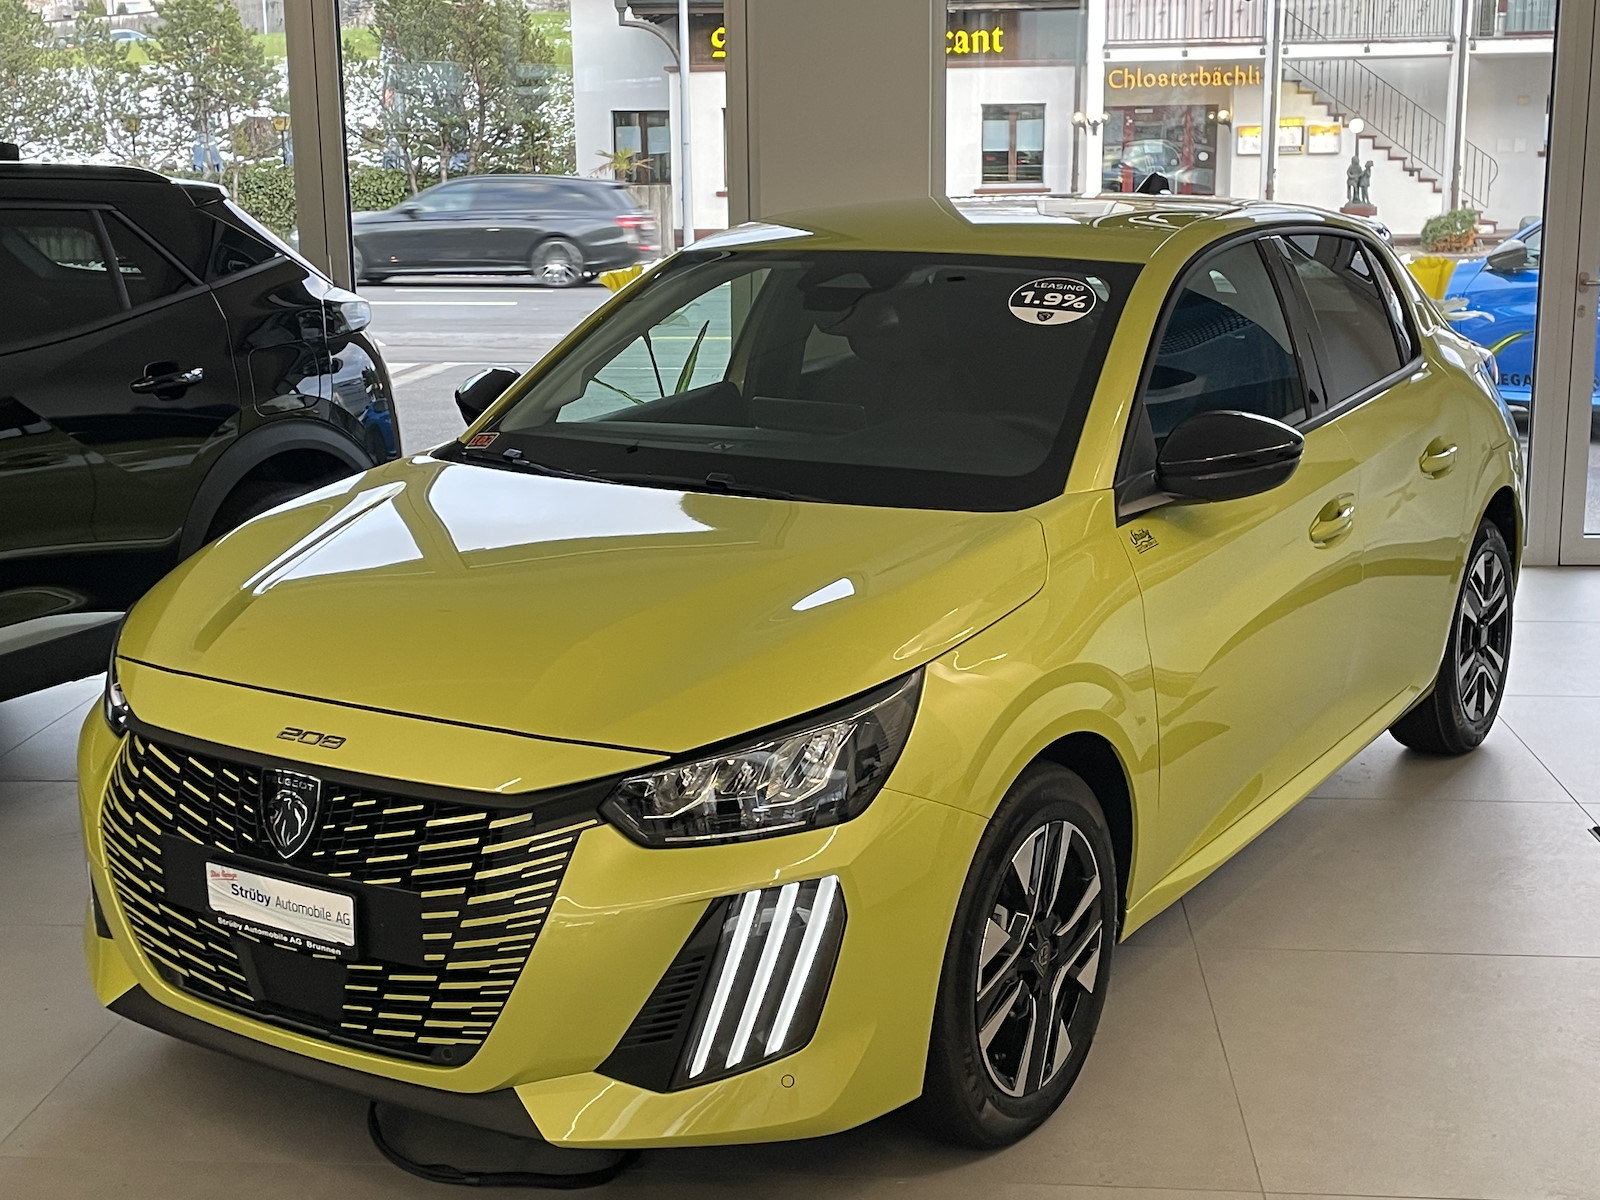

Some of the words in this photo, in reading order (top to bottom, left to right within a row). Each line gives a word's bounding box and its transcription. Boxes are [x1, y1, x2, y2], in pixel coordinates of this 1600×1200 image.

[1108, 65, 1262, 91] Chlosterbächli
[1034, 282, 1084, 291] LEASING
[1020, 290, 1088, 309] 1.9%
[277, 727, 347, 750] 208
[231, 883, 271, 907] Strüby
[275, 896, 332, 922] Automobile
[335, 911, 351, 926] AG
[217, 916, 243, 931] Strüby
[244, 924, 288, 942] Automobile
[289, 936, 303, 946] AG
[306, 940, 342, 956] Brunnen
